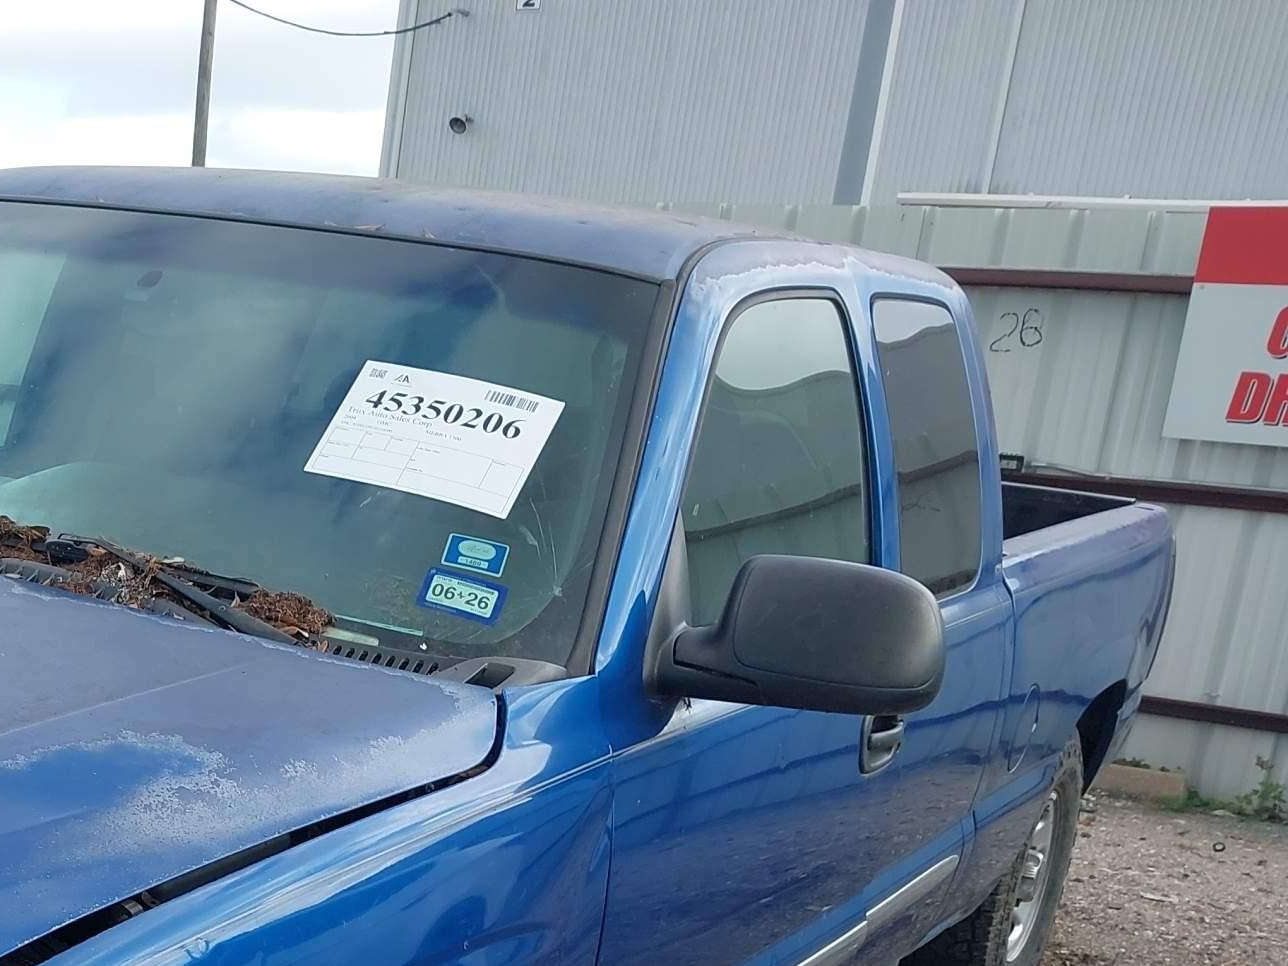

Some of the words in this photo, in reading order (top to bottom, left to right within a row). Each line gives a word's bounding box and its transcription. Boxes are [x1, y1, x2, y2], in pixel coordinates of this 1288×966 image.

[989, 307, 1043, 352] 26
[365, 389, 527, 439] 45350206
[368, 409, 389, 419] Auto
[390, 413, 410, 423] Sales
[412, 418, 433, 429] Corp
